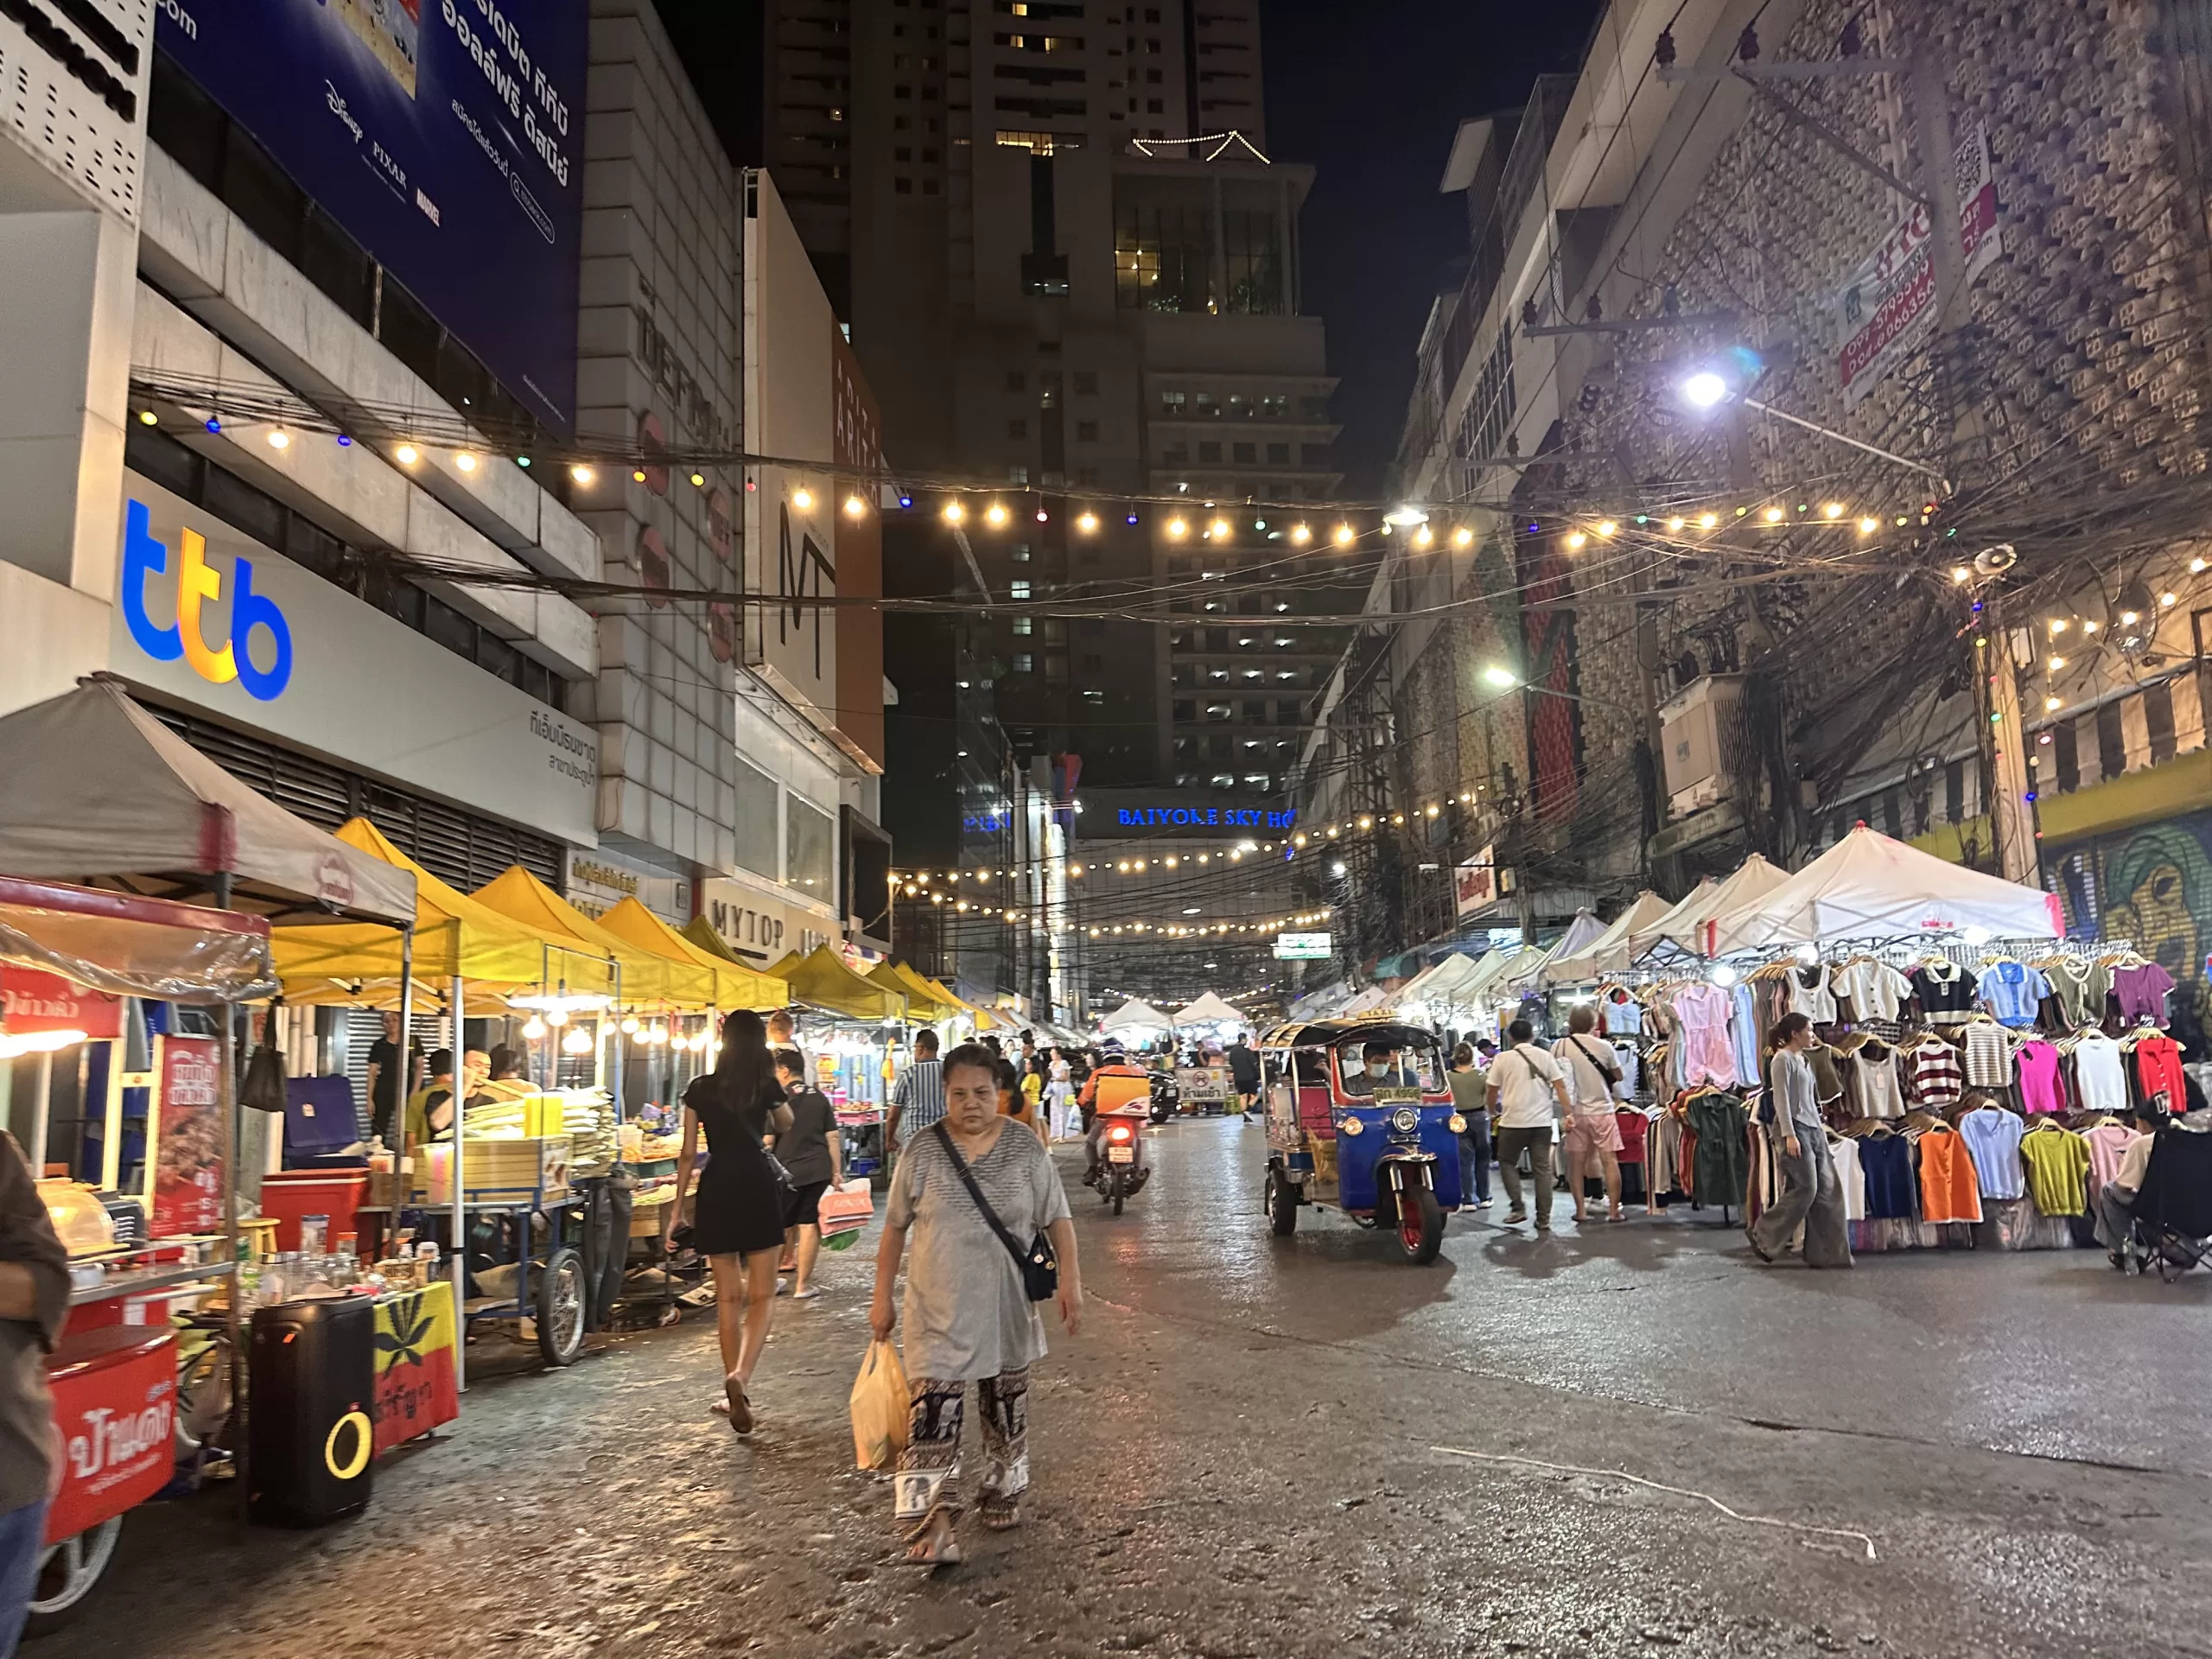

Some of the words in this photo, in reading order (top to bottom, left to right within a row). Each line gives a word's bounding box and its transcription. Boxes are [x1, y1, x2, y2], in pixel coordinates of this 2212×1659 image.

[372, 140, 408, 191] PIXAR
[121, 498, 293, 701] ttb
[1118, 808, 1218, 826] BAIYOKE
[1224, 809, 1262, 827] SKY
[713, 899, 785, 950] MYTOP
[1366, 1008, 1393, 1017] TAXI
